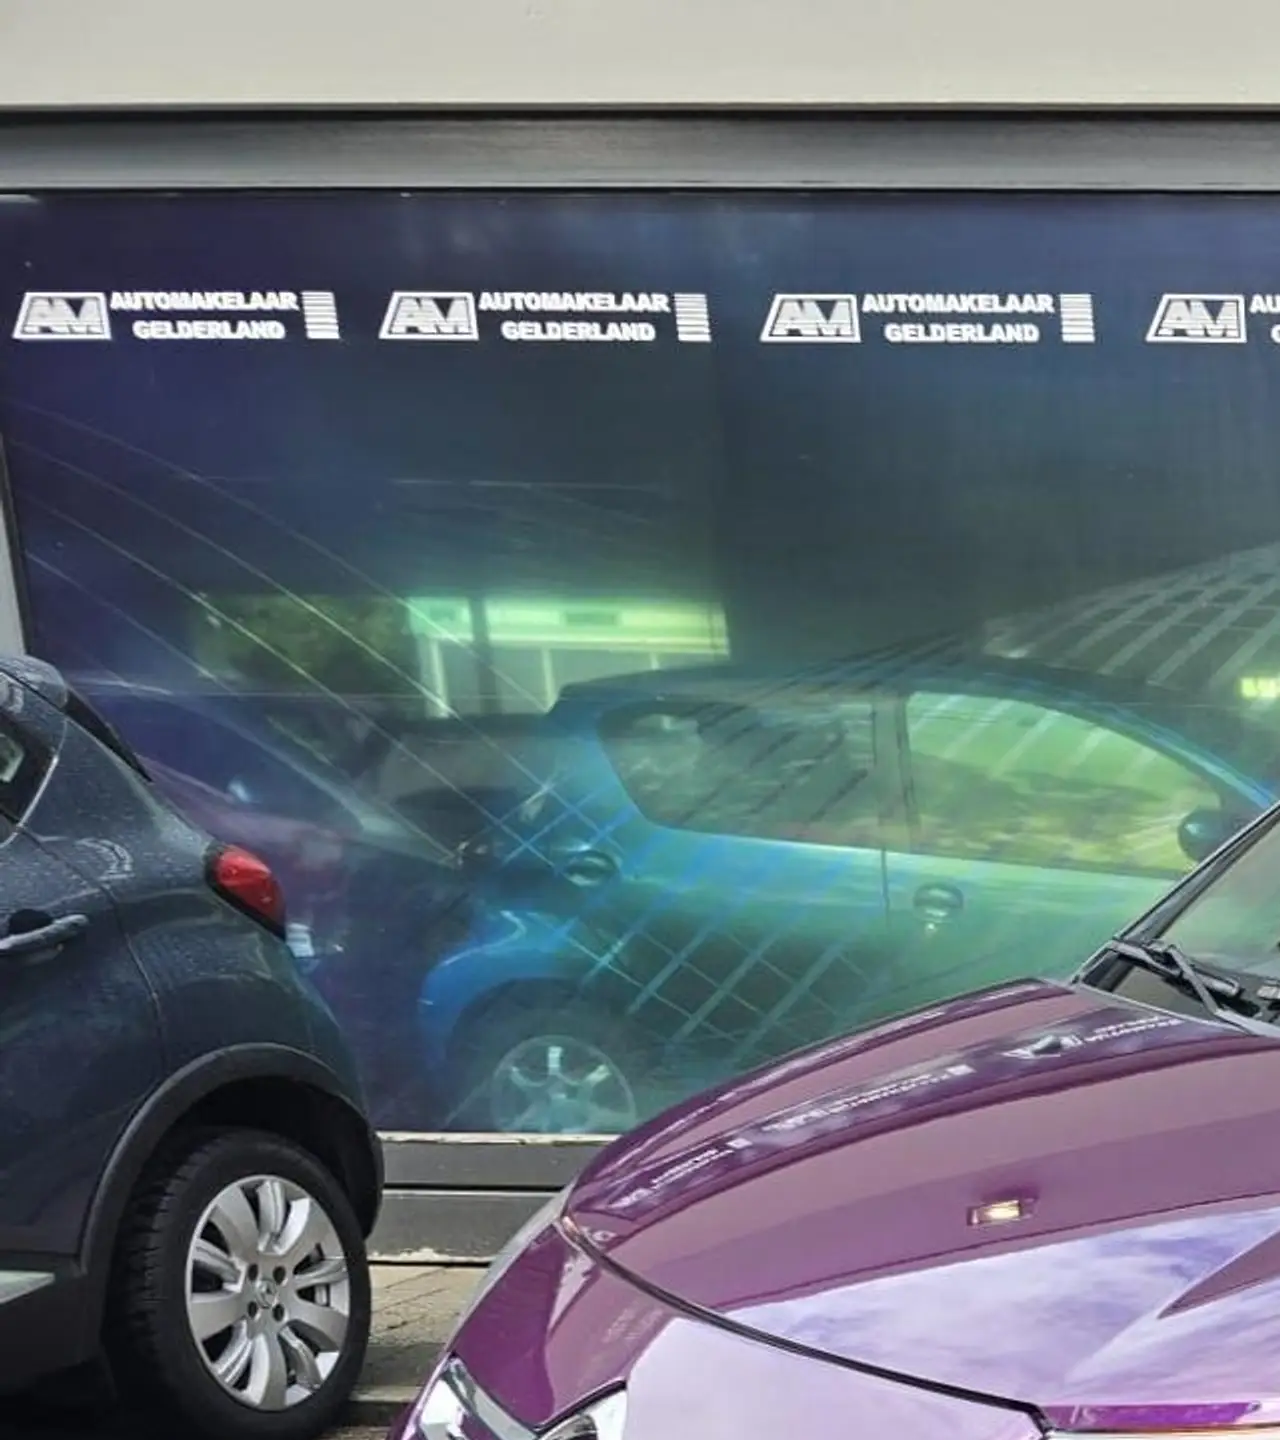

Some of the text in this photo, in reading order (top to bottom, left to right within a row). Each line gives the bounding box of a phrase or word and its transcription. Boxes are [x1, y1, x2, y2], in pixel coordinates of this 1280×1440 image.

[110, 292, 304, 313] AUTOMAKELAAR
[479, 292, 672, 314] AUTOMAKELAAR
[862, 294, 1056, 315] AUTOMAKELAAR
[132, 321, 287, 341] GELDERLAND
[501, 321, 657, 342] GELDERLAND
[884, 324, 1041, 344] GELDERLAND
